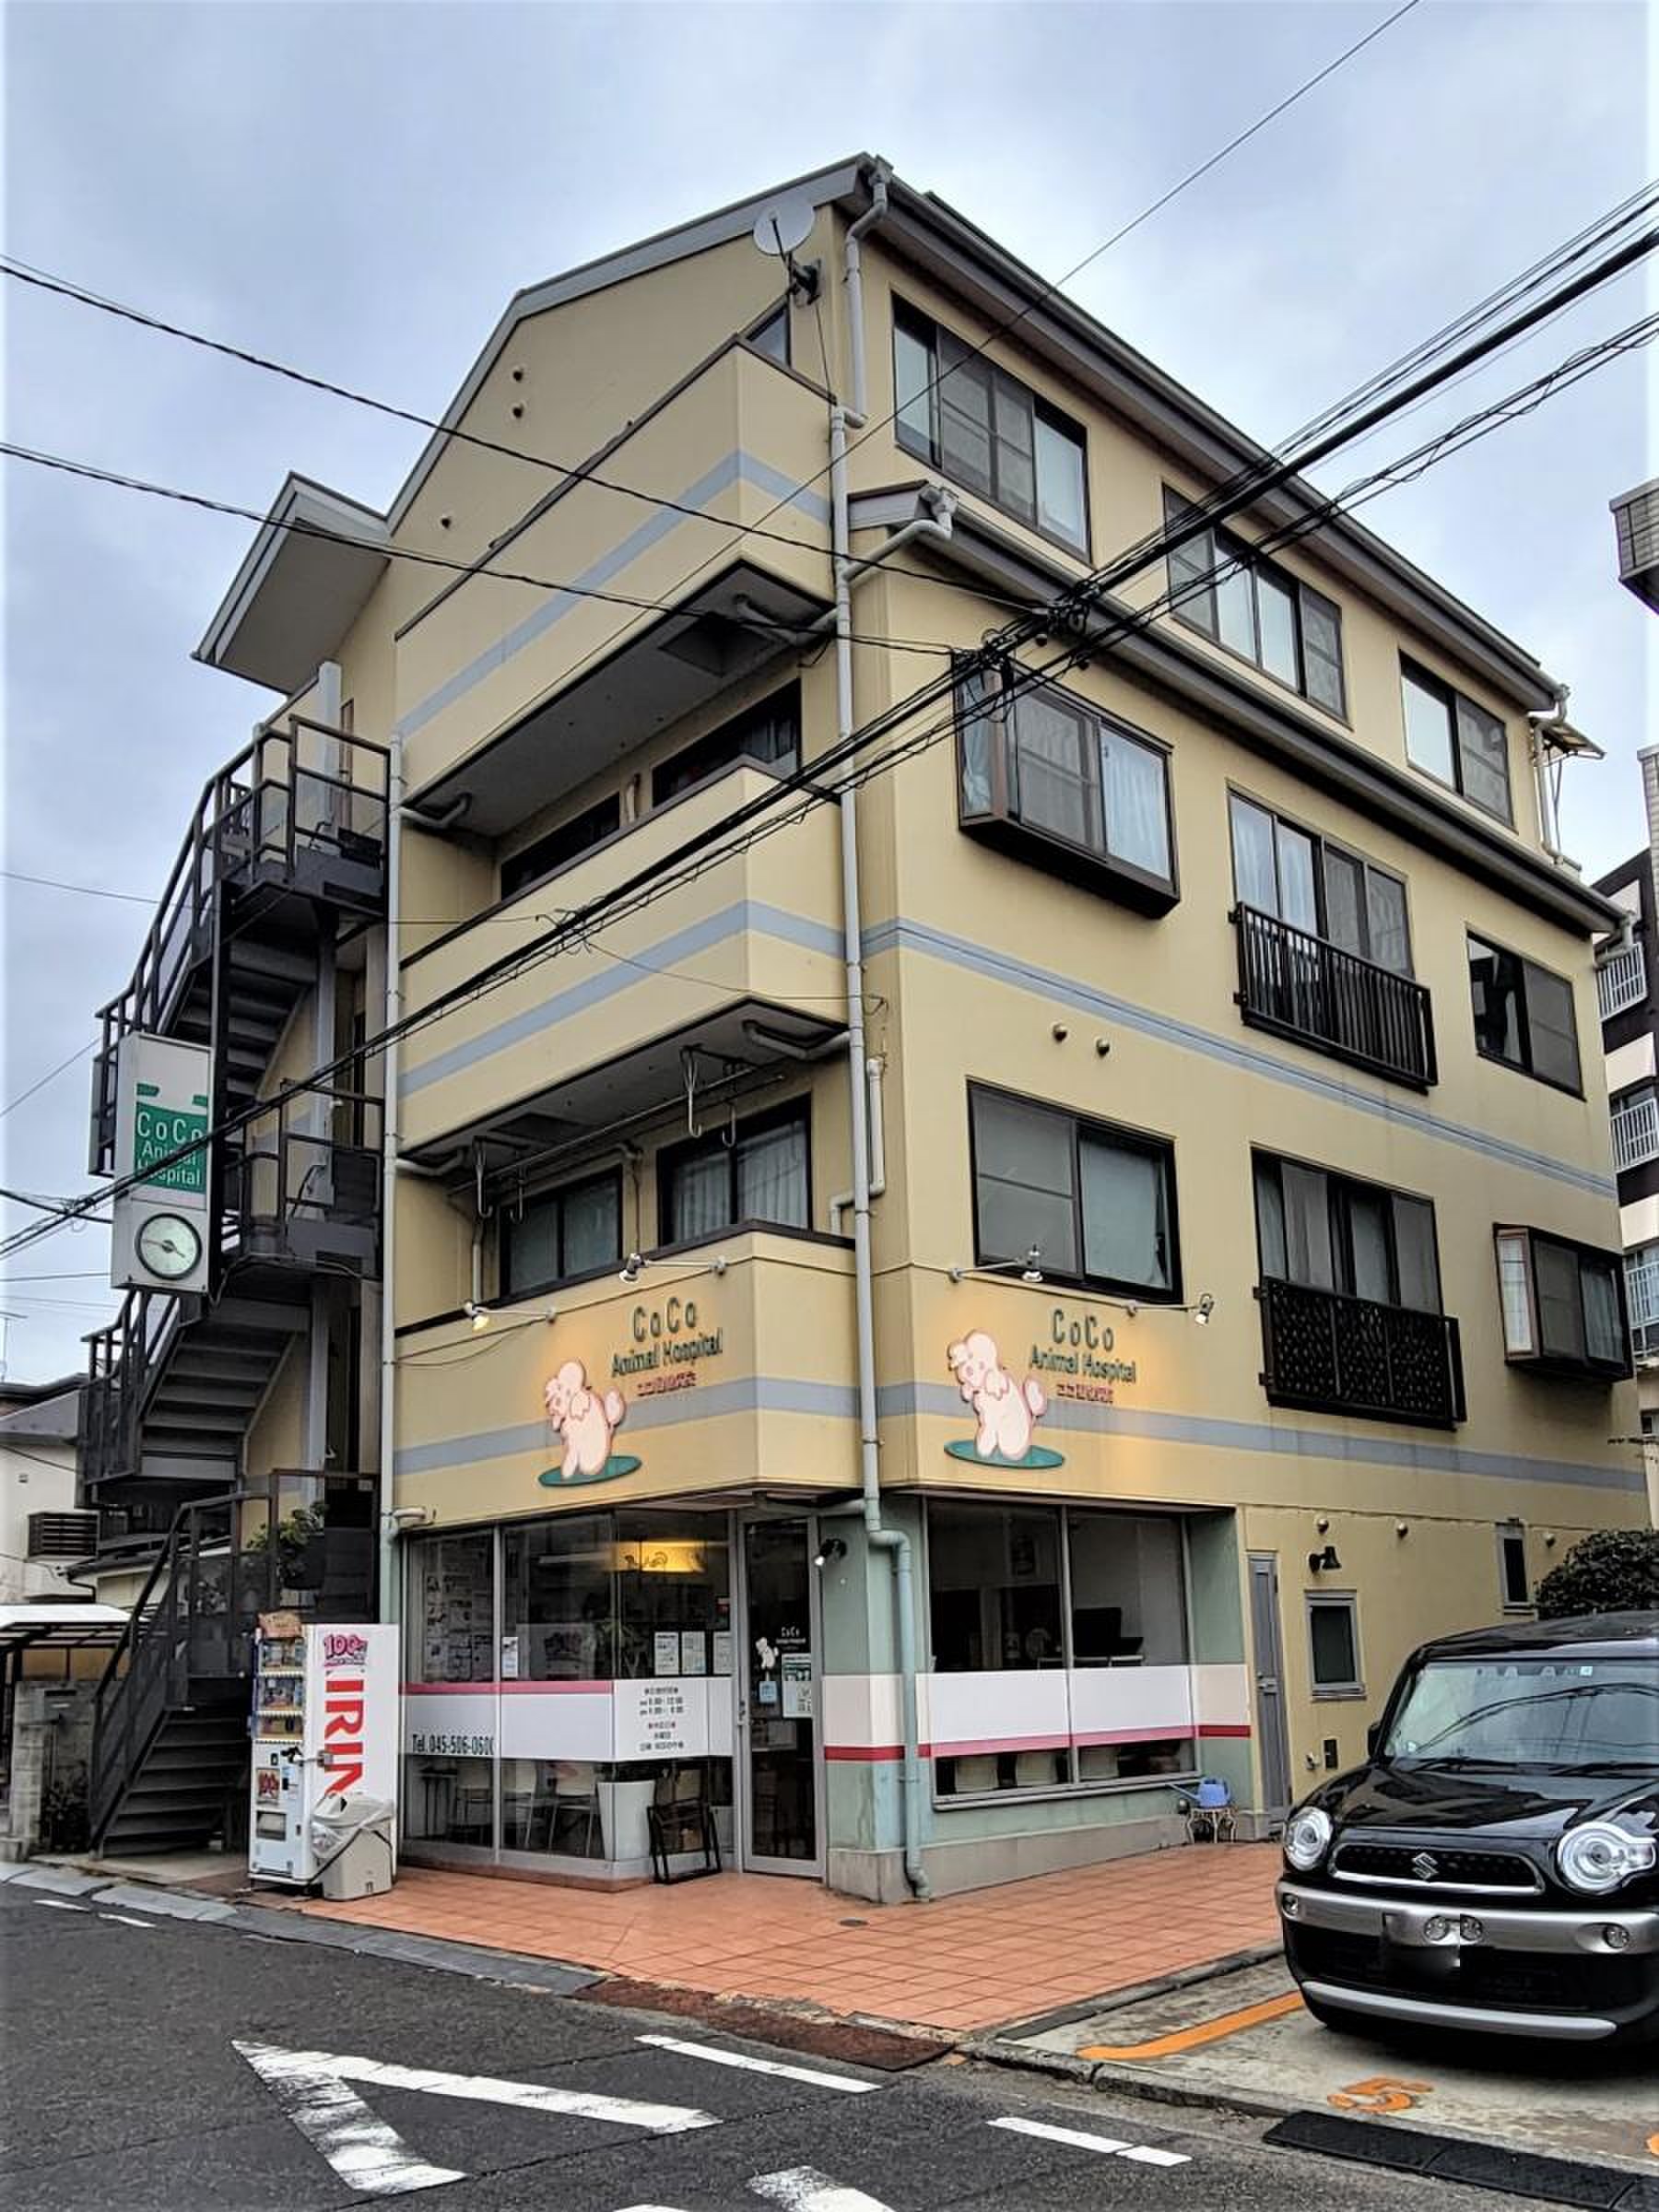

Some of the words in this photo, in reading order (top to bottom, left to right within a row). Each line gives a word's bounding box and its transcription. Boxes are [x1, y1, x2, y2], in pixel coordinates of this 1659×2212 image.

[633, 1297, 696, 1342] CoCo
[1053, 1308, 1114, 1352] CoCo
[611, 1341, 661, 1378] Animal
[663, 1327, 723, 1366] Hospital
[1029, 1344, 1078, 1375] Animal
[1082, 1350, 1136, 1385] Hospital
[324, 1669, 364, 1796] IRIN
